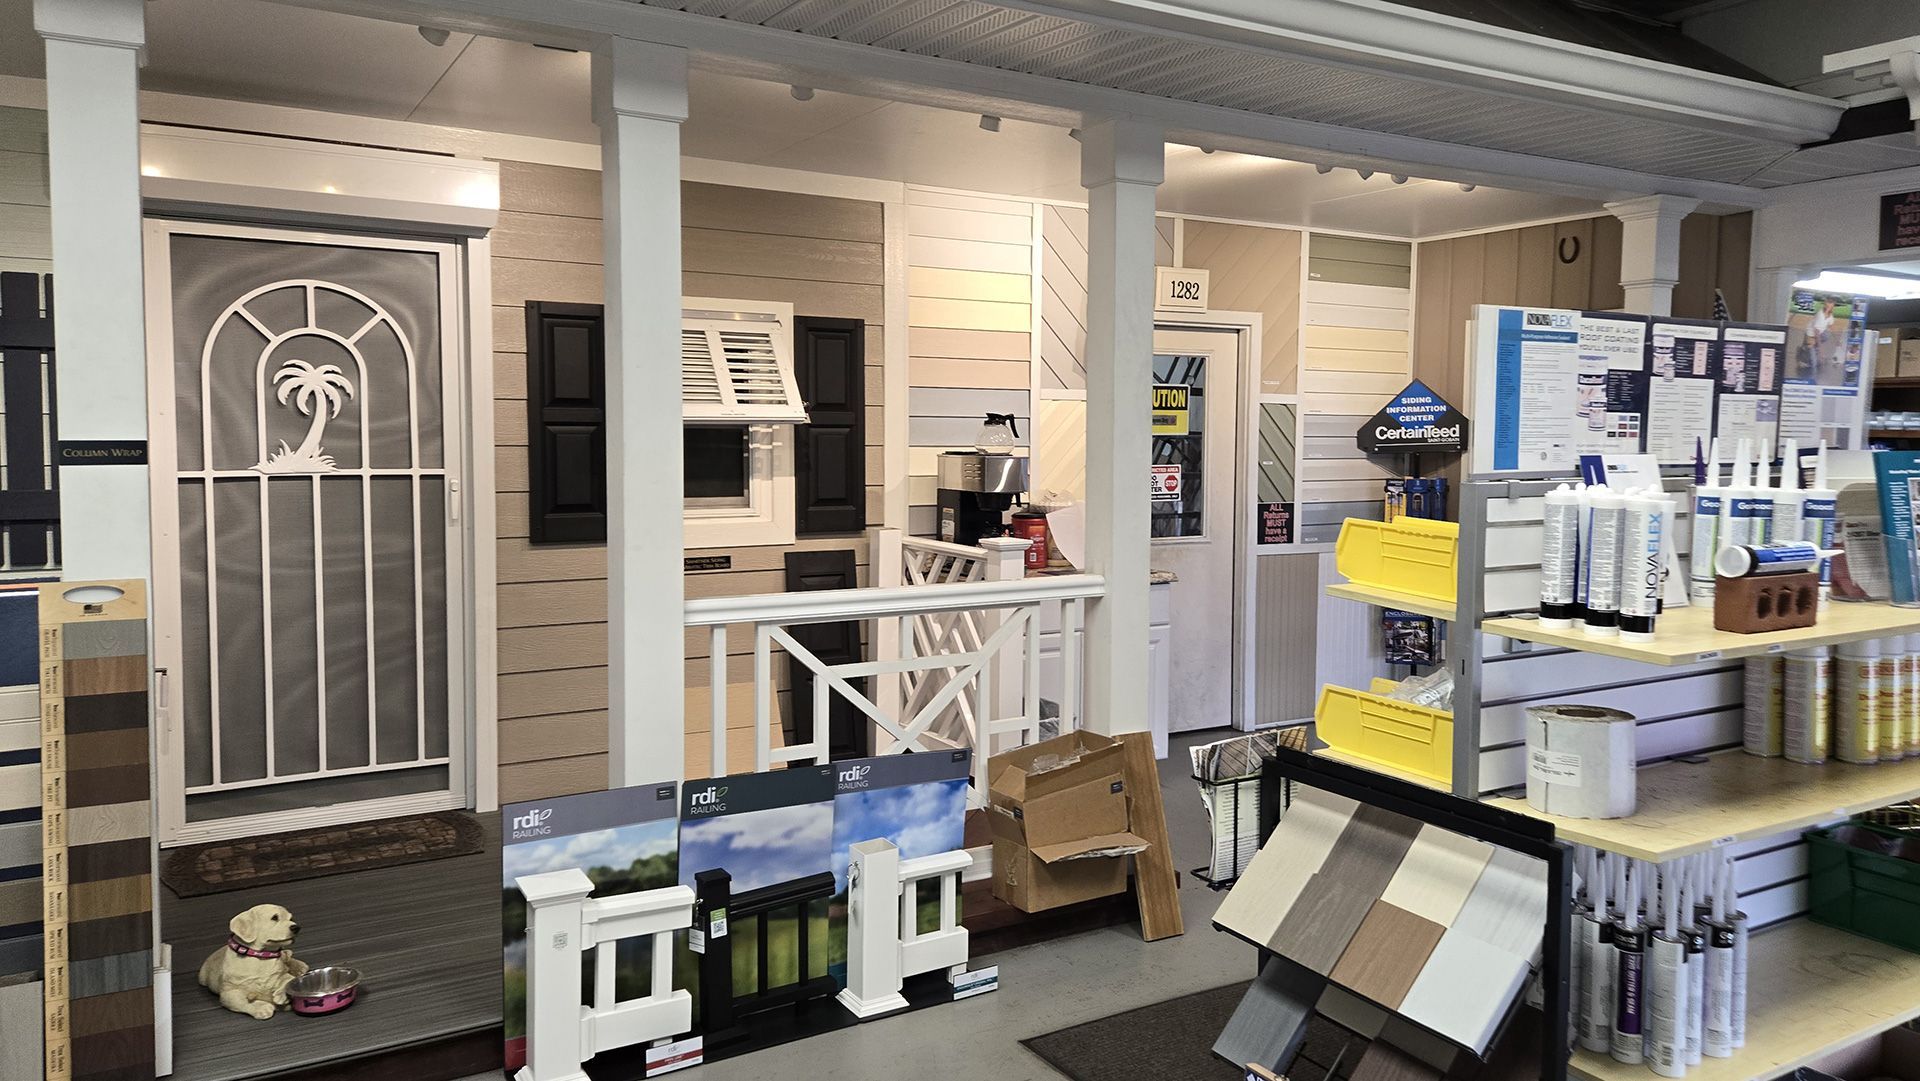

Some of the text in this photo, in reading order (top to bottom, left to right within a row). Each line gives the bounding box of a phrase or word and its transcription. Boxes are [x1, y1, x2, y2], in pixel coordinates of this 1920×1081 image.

[1171, 280, 1200, 300] 1282
[1527, 312, 1573, 330] NOVAFLEX
[1580, 333, 1639, 344] ROOF COATING
[1153, 388, 1187, 408] UTION
[1401, 396, 1432, 404] SIDING
[1386, 404, 1447, 414] INFORMATION
[1399, 414, 1435, 422] CENTER
[1375, 424, 1460, 440] CertainTeed
[1165, 479, 1178, 487] STOP
[1269, 503, 1284, 511] ALL
[1263, 511, 1290, 520] Returns
[1266, 519, 1286, 527] MUST
[1265, 527, 1281, 535] have
[1264, 535, 1288, 544] receipt
[1645, 512, 1664, 600] NOVAFLEX
[839, 765, 861, 783] rdi
[838, 780, 869, 791] RAILING
[692, 786, 717, 806] rdi
[690, 803, 727, 815] RAILING
[513, 809, 539, 830] rdi
[512, 826, 551, 839] RAILING
